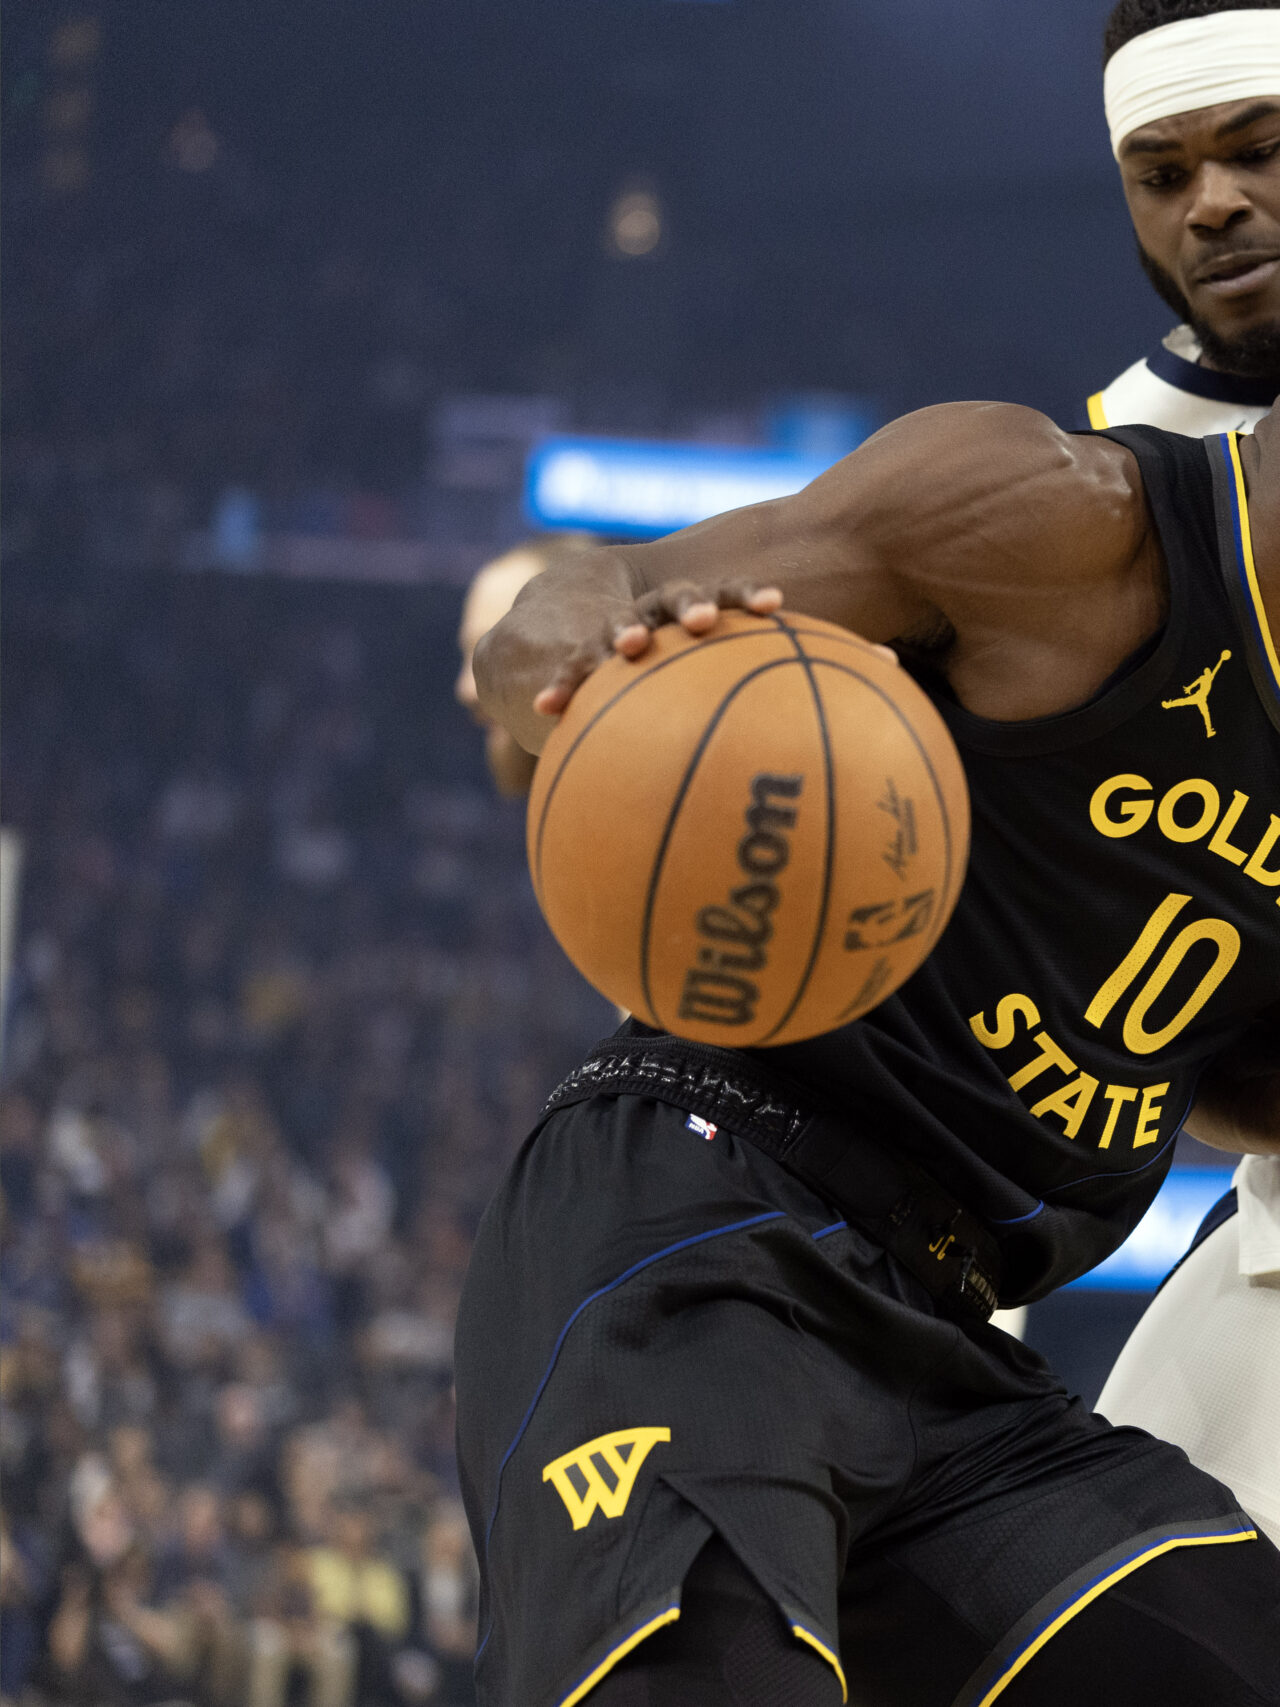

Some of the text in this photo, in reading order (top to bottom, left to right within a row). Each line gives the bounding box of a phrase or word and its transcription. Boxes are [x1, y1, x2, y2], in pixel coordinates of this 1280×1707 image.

[678, 772, 804, 1027] Wilson
[1084, 892, 1242, 1055] 10
[968, 993, 1171, 1149] STATE
